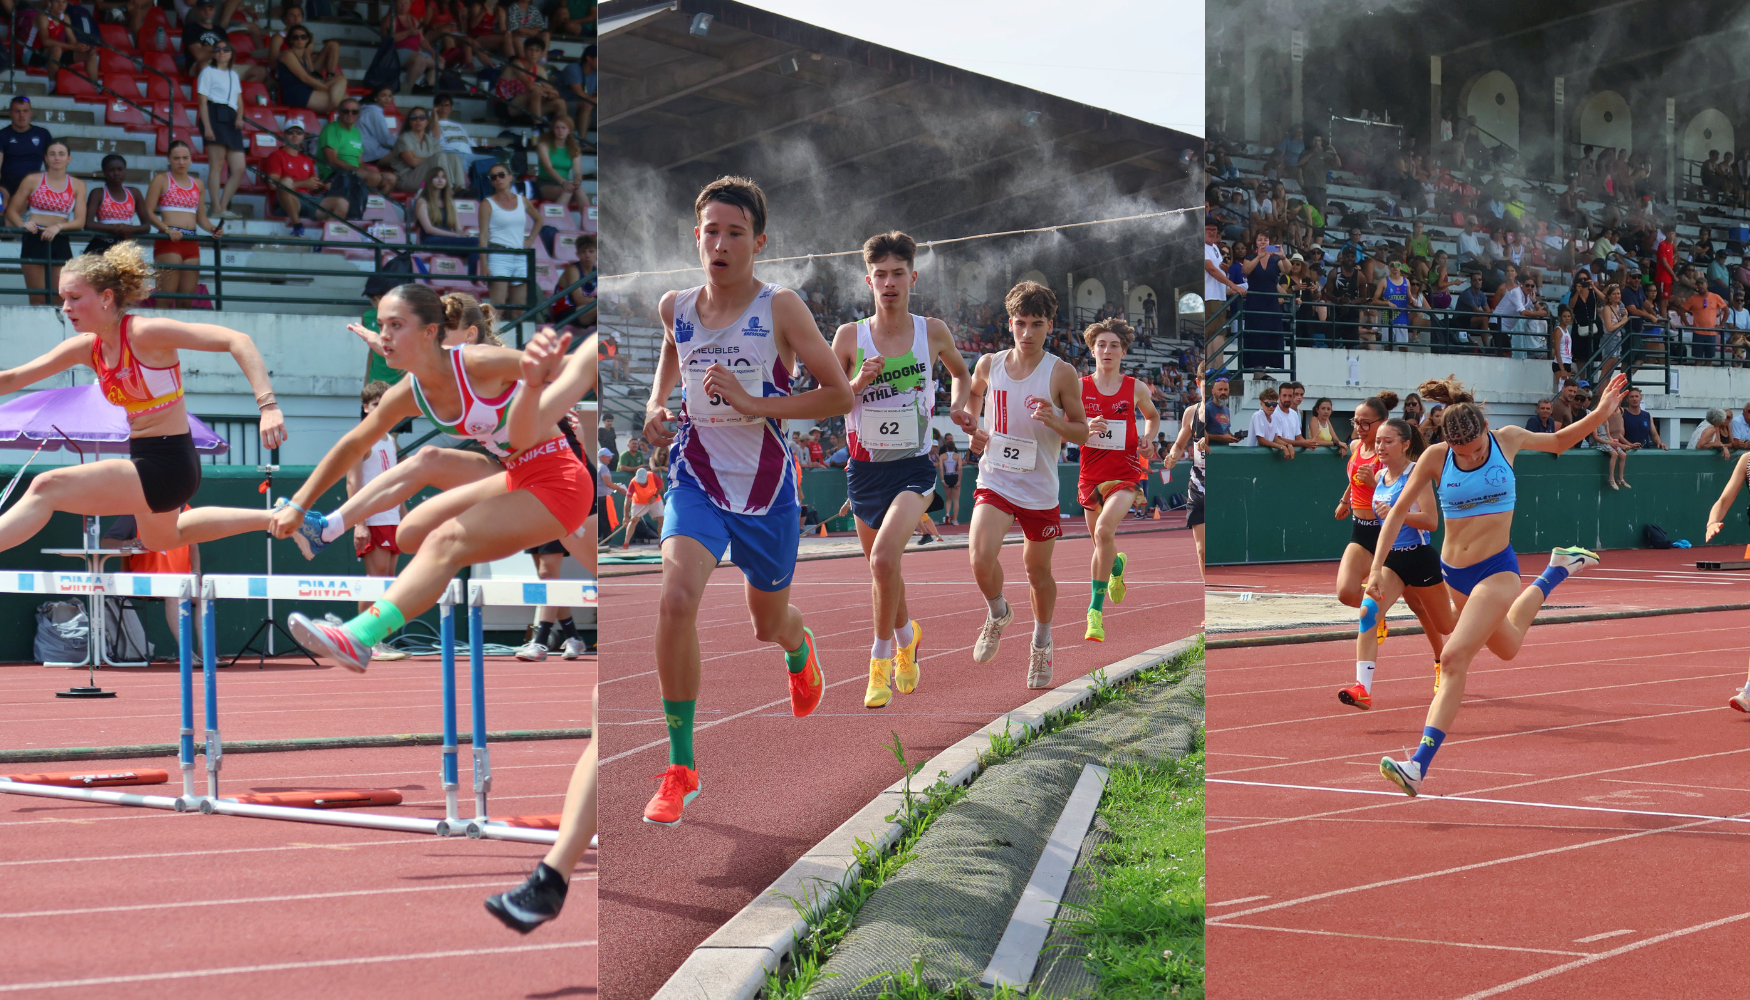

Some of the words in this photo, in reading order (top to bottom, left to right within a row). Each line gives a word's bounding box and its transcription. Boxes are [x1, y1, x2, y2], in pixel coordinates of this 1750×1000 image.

[45, 111, 53, 121] F
[58, 112, 66, 122] 8
[96, 140, 104, 151] F
[110, 141, 117, 152] 7
[692, 346, 740, 354] MEUBLES
[862, 383, 899, 404] ATHLÉ
[879, 421, 899, 435] 62
[518, 441, 557, 466] NIKE
[1003, 446, 1020, 460] 52
[60, 575, 105, 592] DIMA
[298, 580, 351, 597] DIMA
